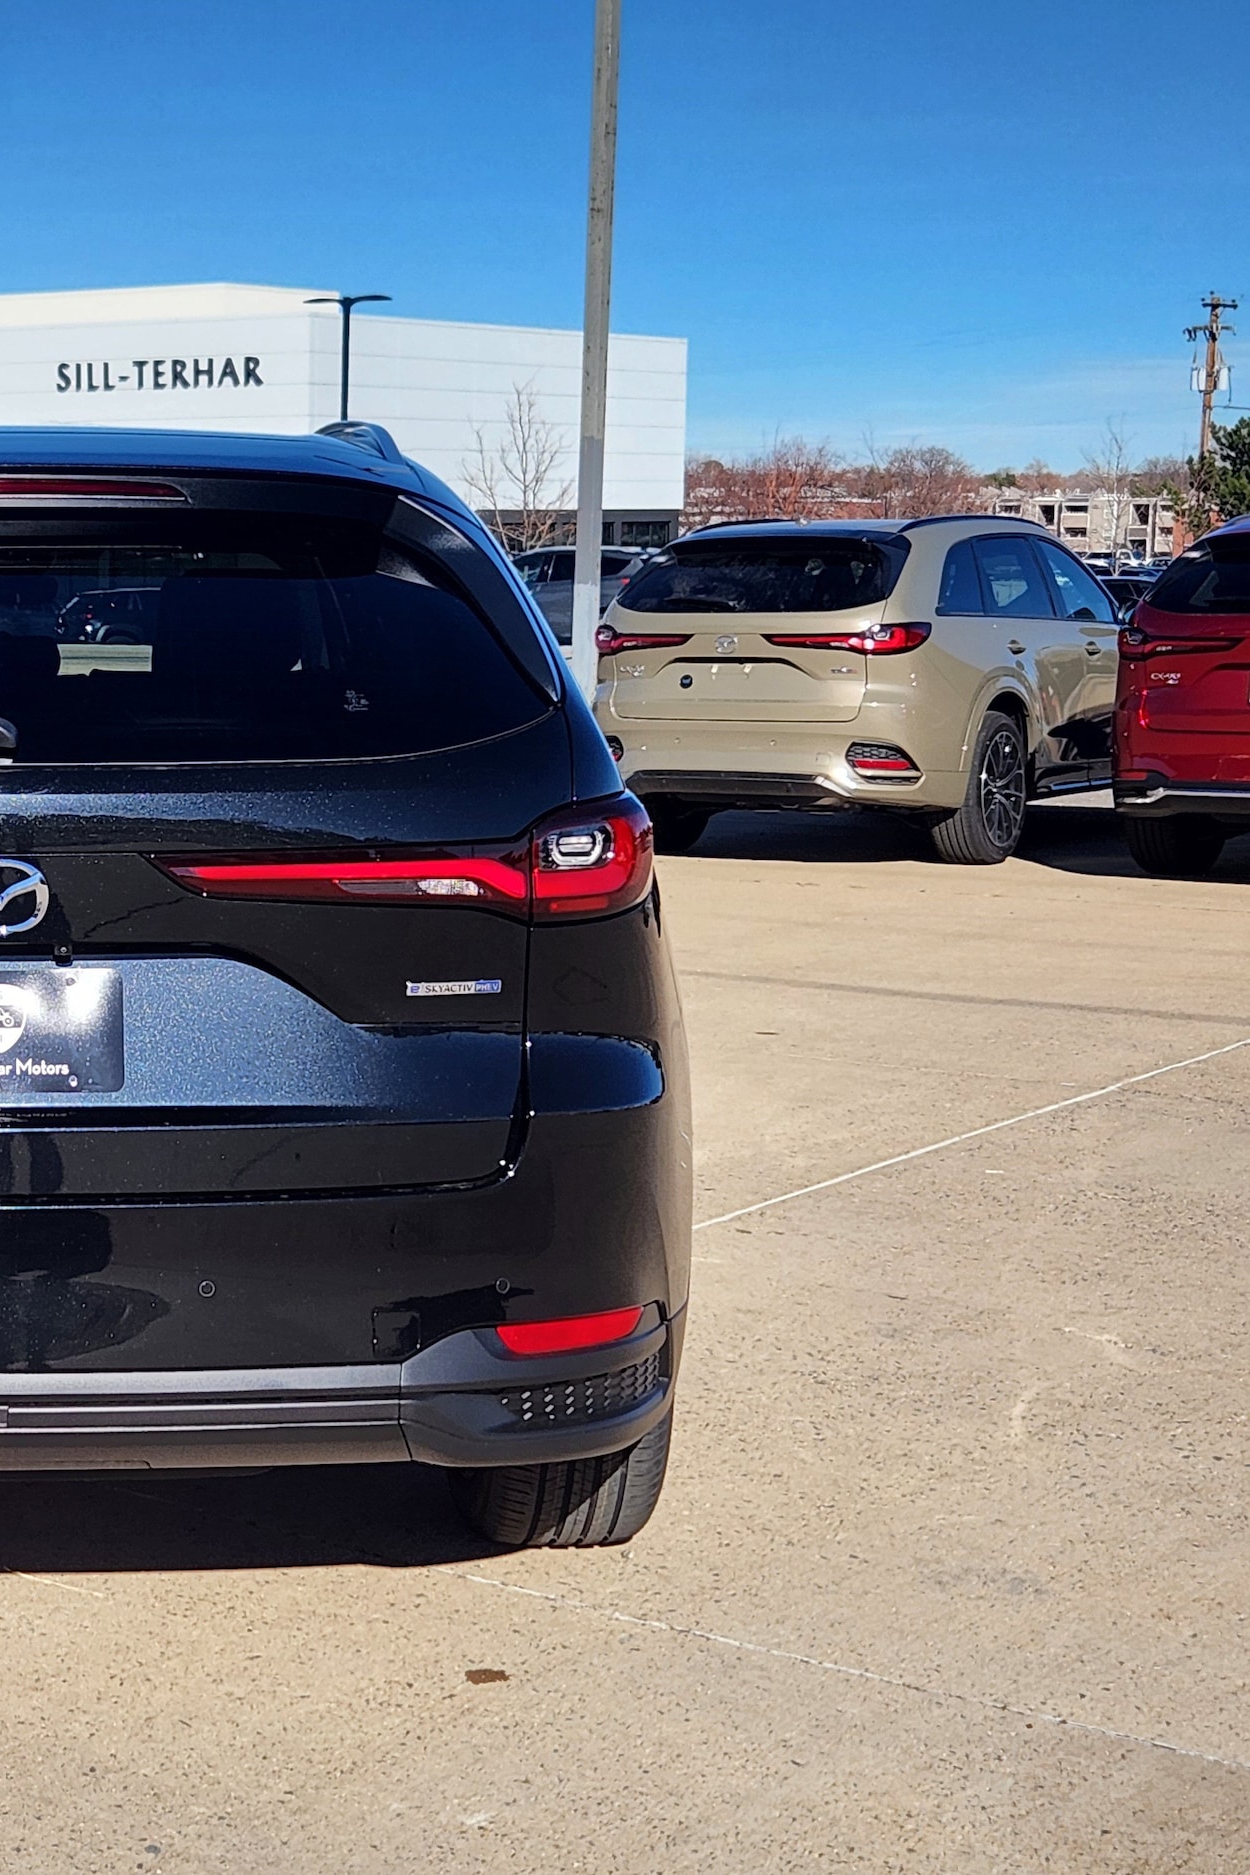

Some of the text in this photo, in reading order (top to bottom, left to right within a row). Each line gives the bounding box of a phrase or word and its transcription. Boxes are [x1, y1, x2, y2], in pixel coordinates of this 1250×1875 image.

[56, 356, 264, 393] SILL-TERHAR
[425, 984, 473, 993] SKYACTIV
[476, 982, 499, 992] PHEV
[15, 1058, 70, 1076] Motors
